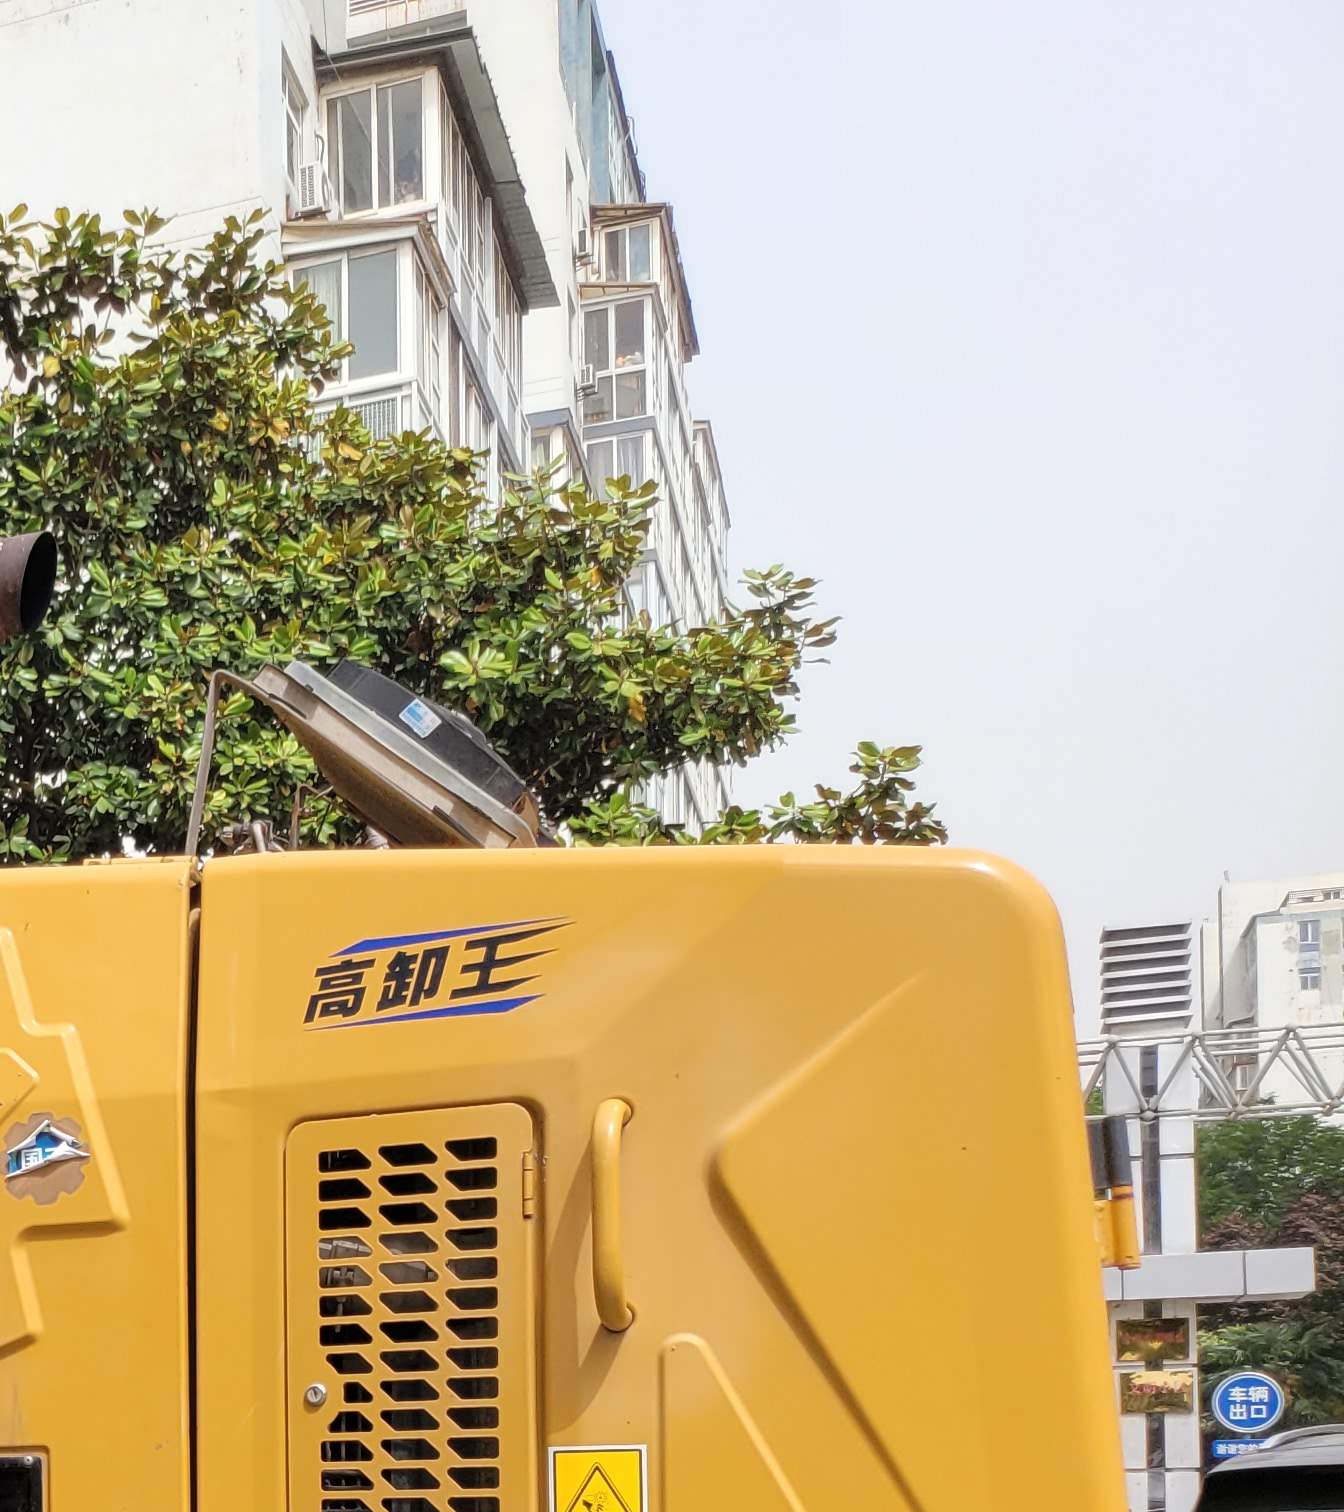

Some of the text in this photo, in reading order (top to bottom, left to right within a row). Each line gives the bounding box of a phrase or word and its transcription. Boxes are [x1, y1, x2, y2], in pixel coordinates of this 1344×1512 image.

[303, 921, 576, 1024] 高卸王
[1228, 1386, 1269, 1402] 车辆
[1229, 1404, 1267, 1420] 出口
